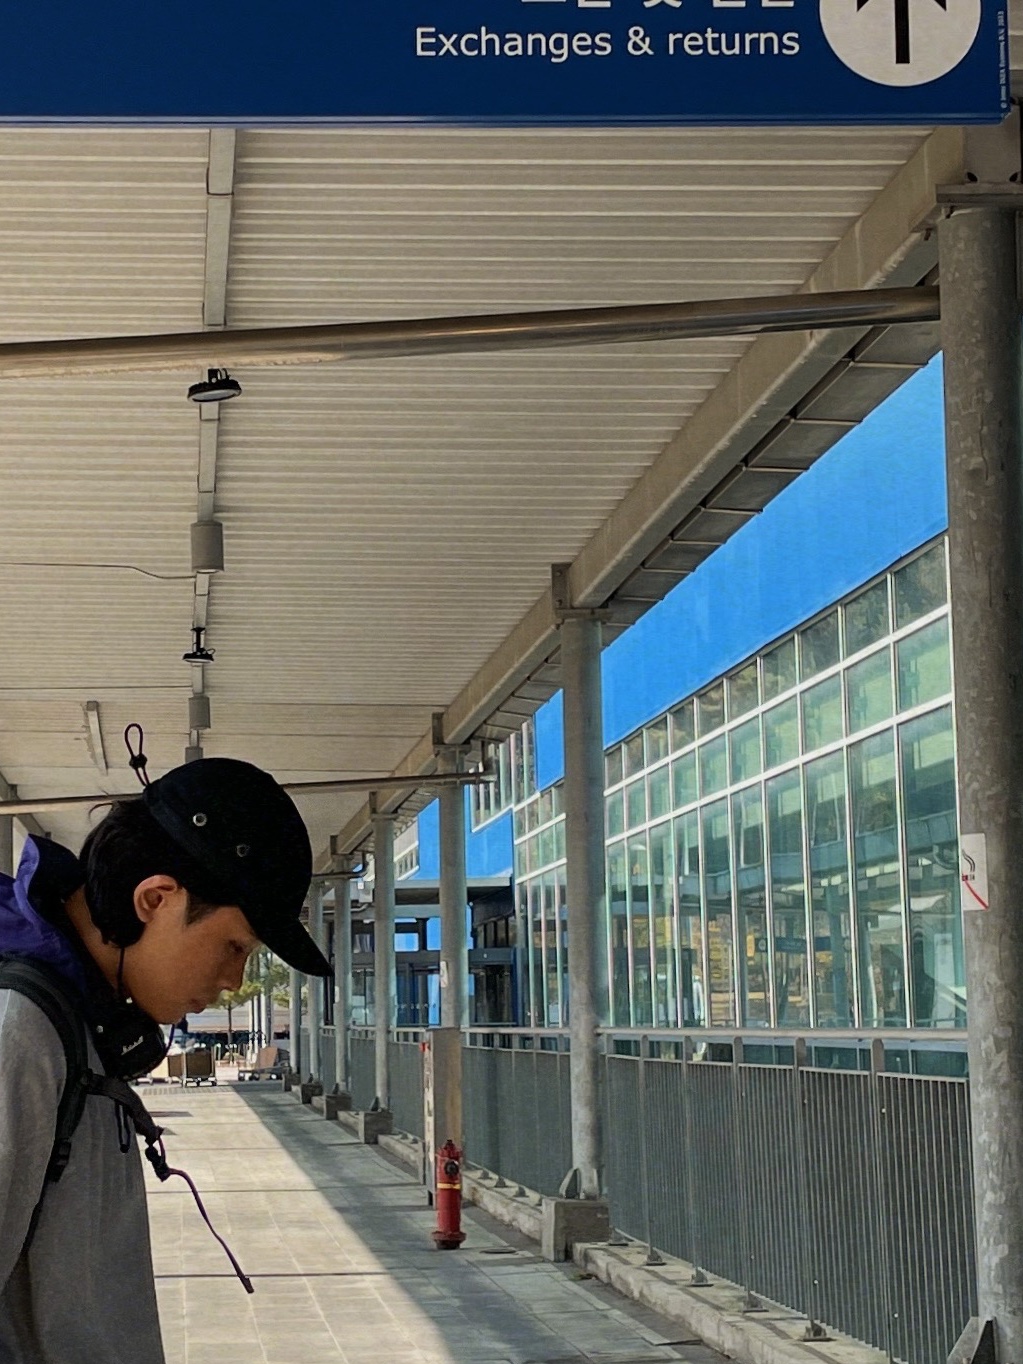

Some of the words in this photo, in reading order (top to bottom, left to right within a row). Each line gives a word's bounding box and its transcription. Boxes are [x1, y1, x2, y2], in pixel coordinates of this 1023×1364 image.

[416, 26, 612, 63] Exchanges
[627, 26, 654, 55] &
[668, 27, 800, 55] returns
